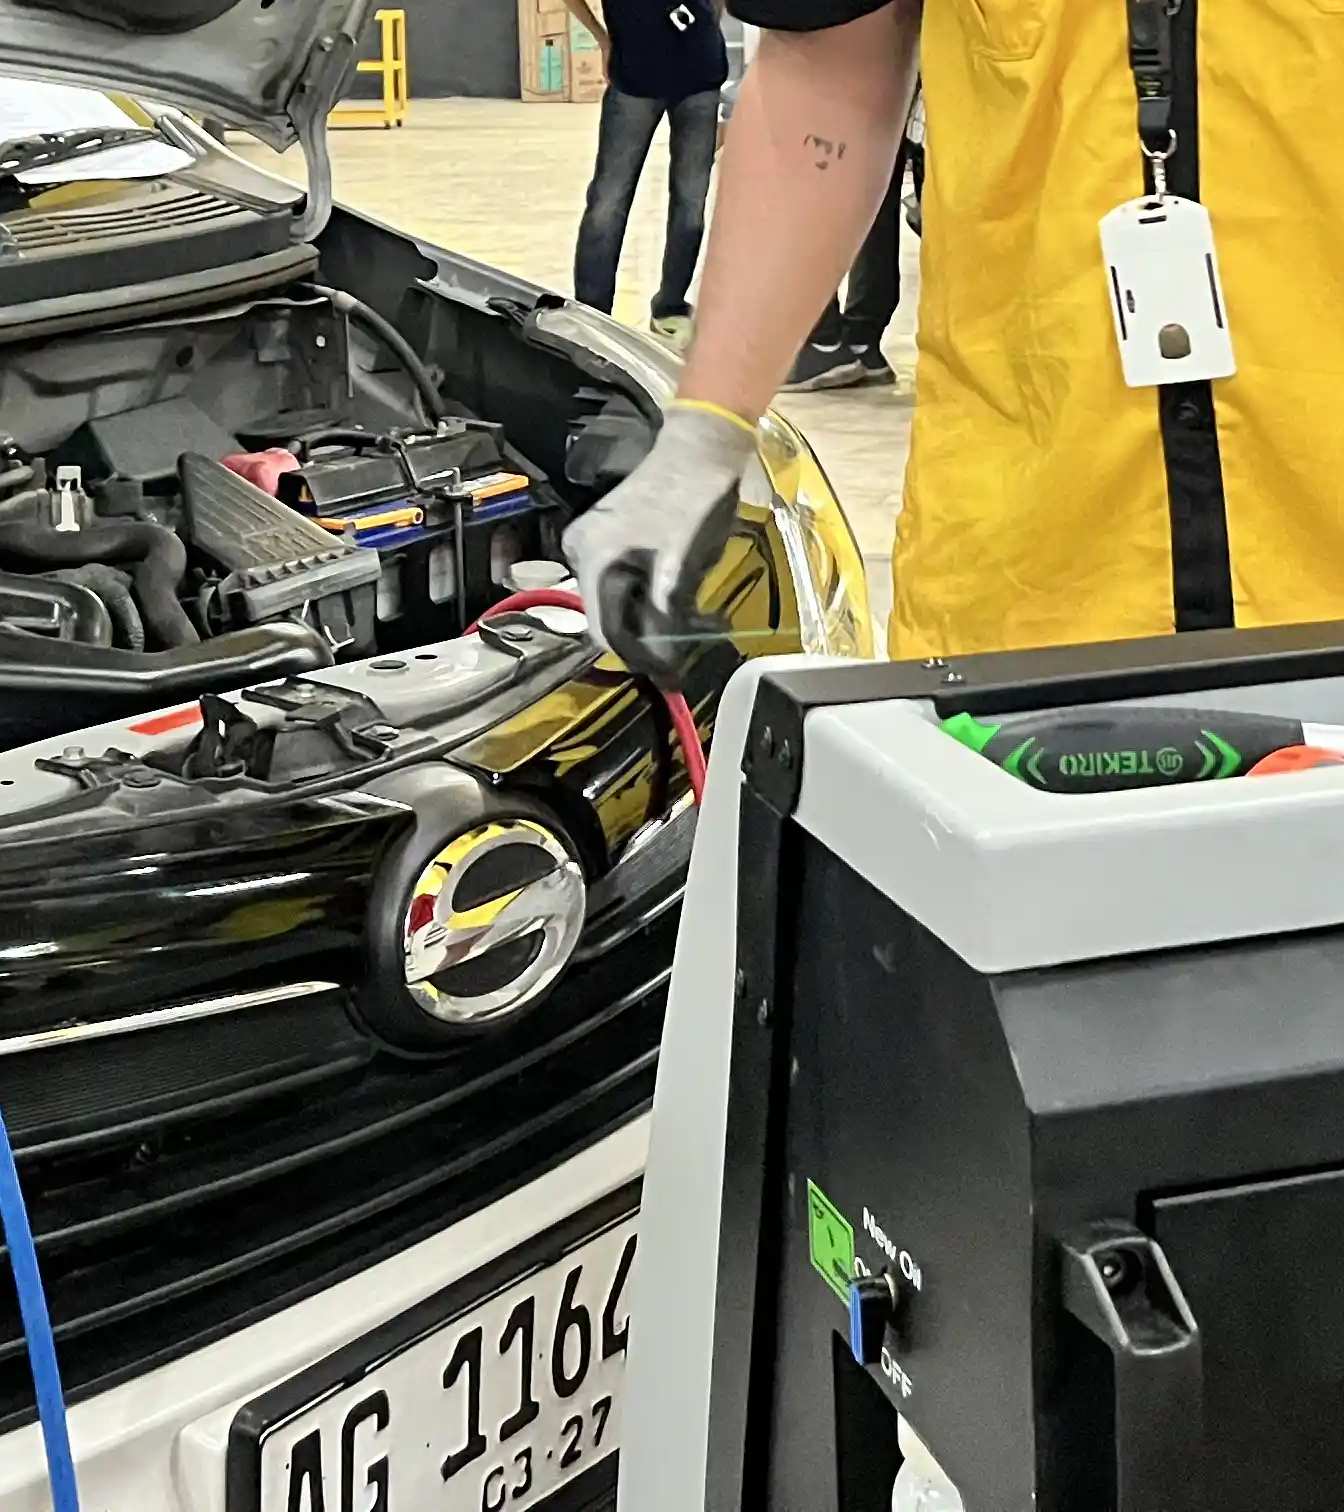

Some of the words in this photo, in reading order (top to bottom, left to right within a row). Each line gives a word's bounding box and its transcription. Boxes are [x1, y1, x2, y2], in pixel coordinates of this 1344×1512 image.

[1058, 749, 1154, 776] TEKIRO
[863, 1206, 897, 1260] New
[899, 1250, 922, 1291] On
[287, 1389, 390, 1512] AG
[441, 1233, 638, 1482] 1164
[881, 1346, 912, 1399] OFF
